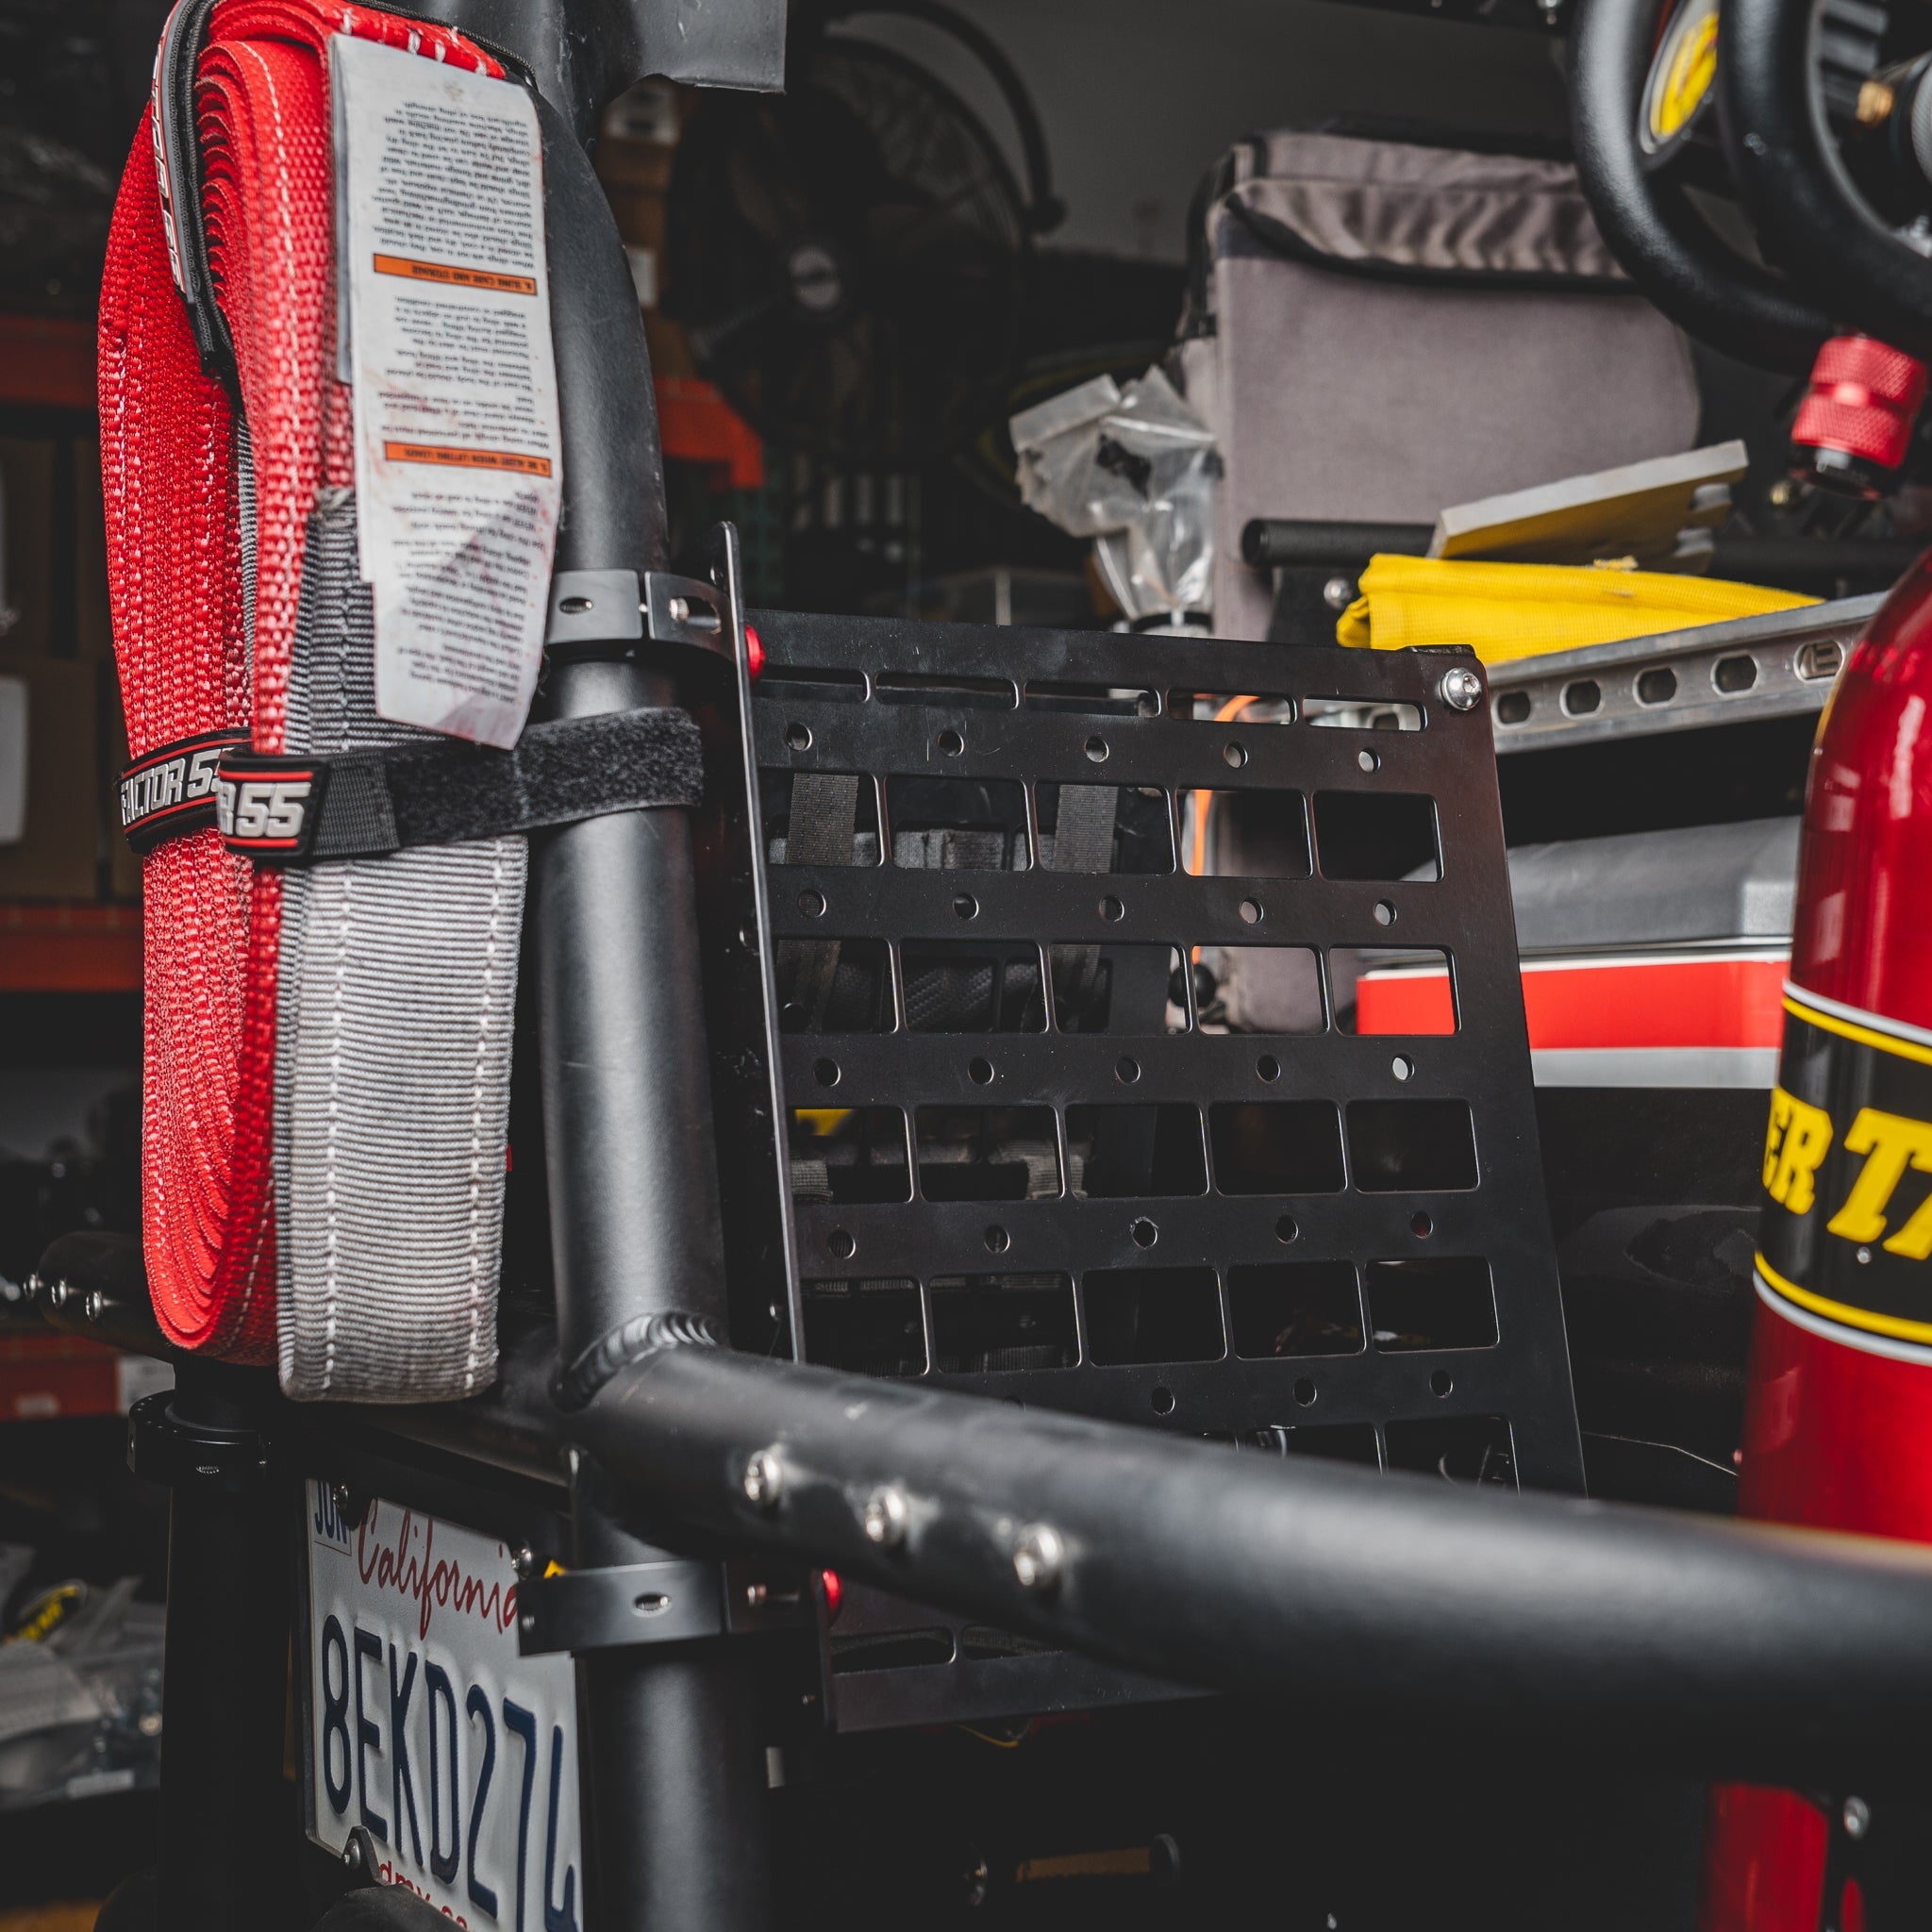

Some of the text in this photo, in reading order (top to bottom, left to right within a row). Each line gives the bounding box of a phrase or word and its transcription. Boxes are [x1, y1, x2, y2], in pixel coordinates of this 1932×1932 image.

[121, 758, 186, 825] FACTOR
[237, 782, 311, 838] 55
[358, 1496, 518, 1641] California
